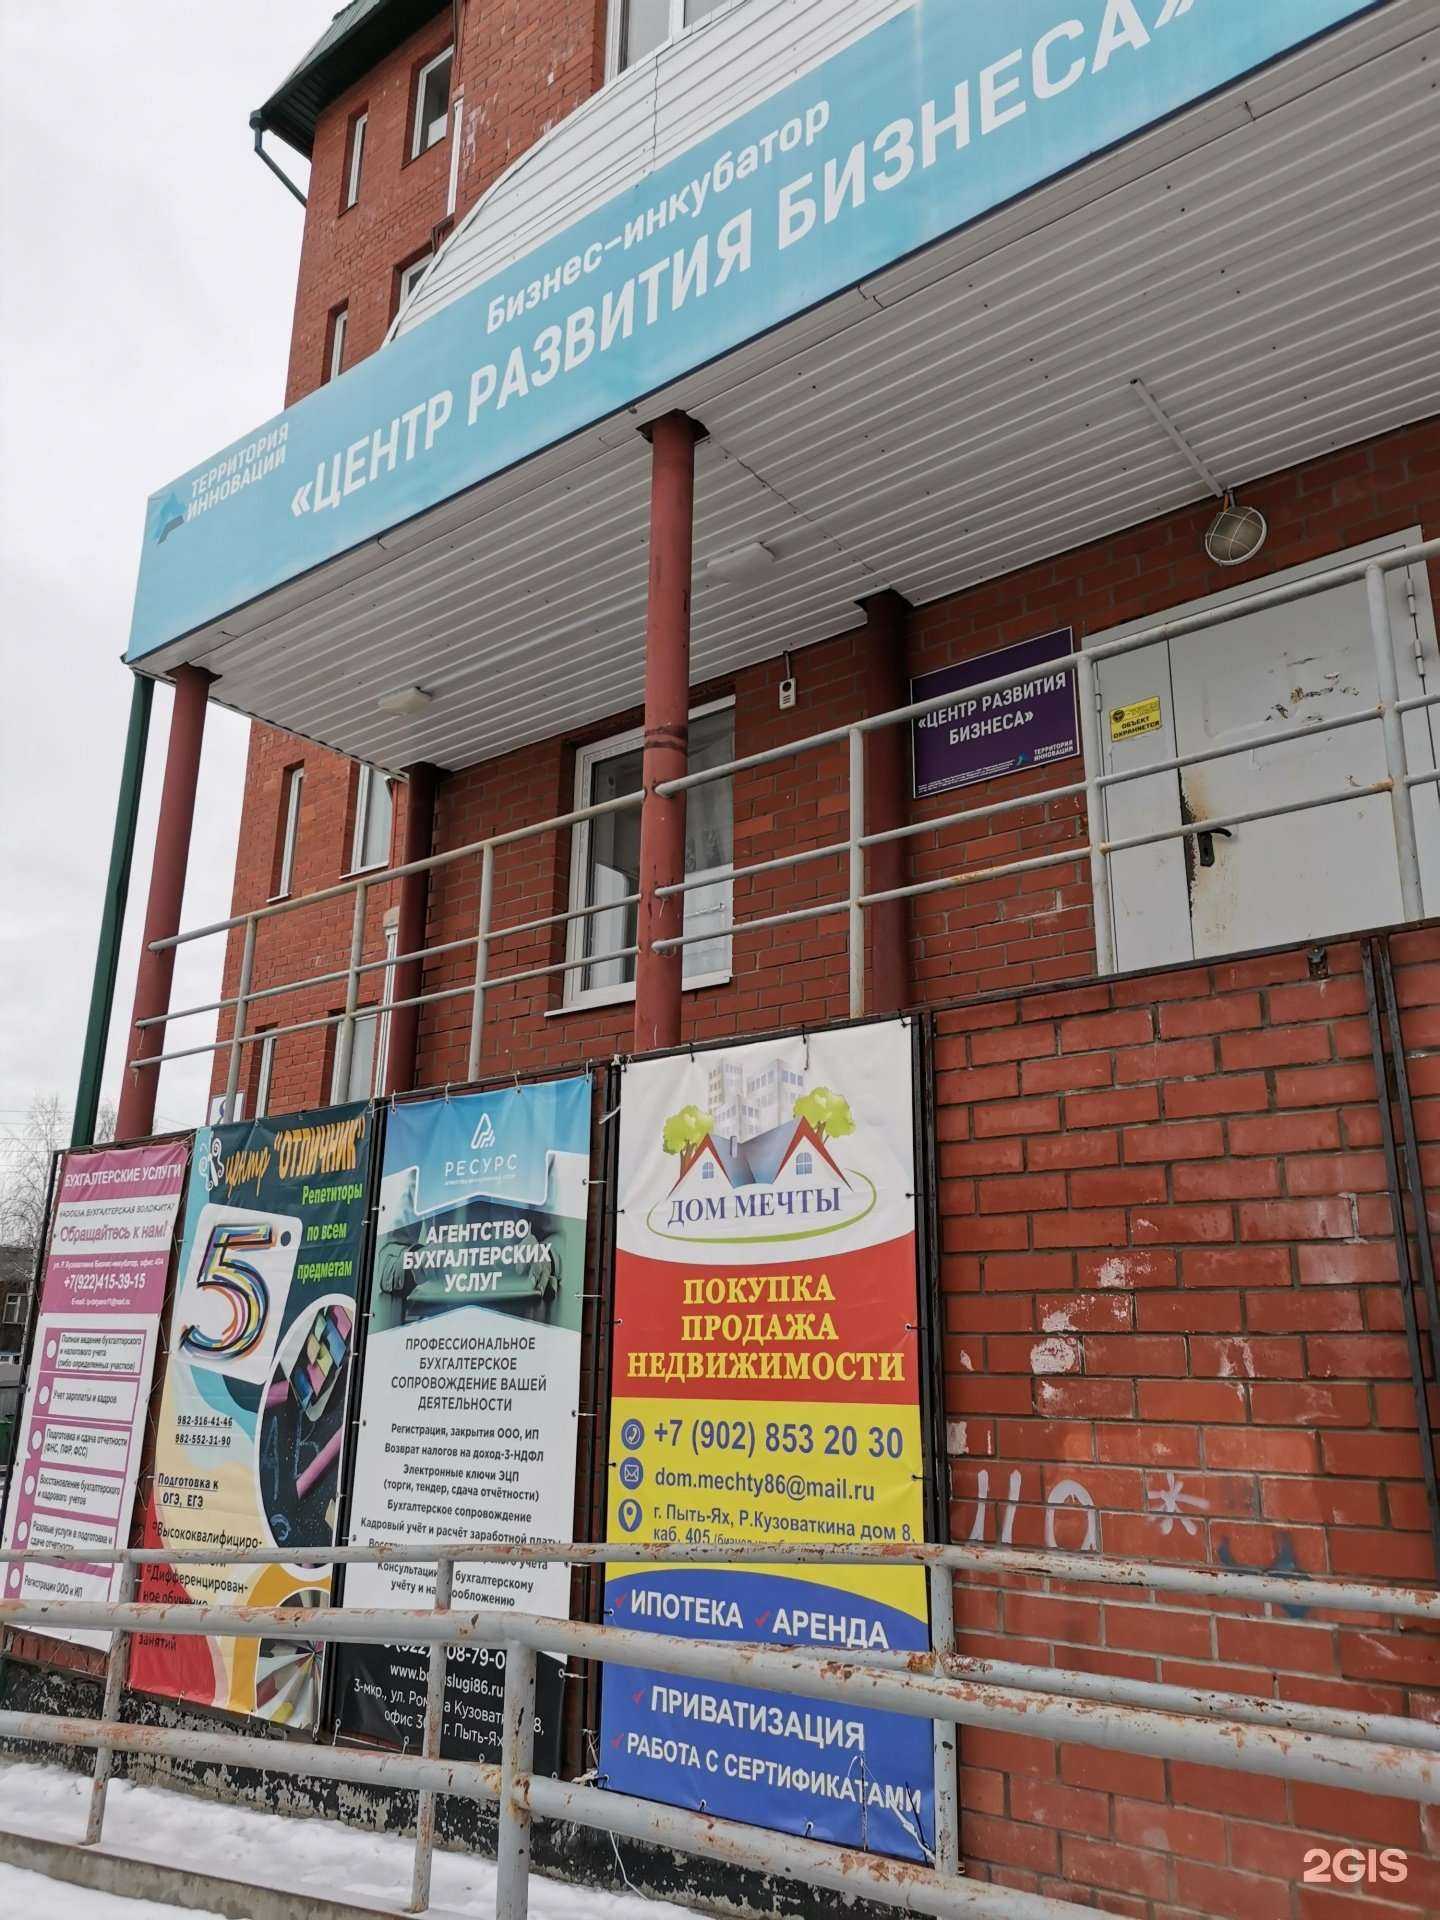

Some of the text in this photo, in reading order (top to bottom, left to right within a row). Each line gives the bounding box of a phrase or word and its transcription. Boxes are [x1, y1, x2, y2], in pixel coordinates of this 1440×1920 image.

[486, 100, 831, 335] Бизнес-инкубатор
[290, 387, 454, 518] «ЦЕНТР
[467, 207, 753, 427] РАЗВИТИЯ
[191, 422, 289, 498] ТЕРРИТОРИЯ
[918, 672, 1066, 729] «ЦЕНТР РАЗВИТИЯ
[949, 710, 1034, 745] БИЗНЕСА»
[64, 1164, 181, 1188] БУХГАЛТЕРСКИЕ УСЛУГИ
[445, 1154, 517, 1176] РЕСУРС
[302, 1184, 362, 1205] Репетиторы
[667, 1187, 841, 1228] ДОМ МЕЧТЫ
[60, 1220, 168, 1245] Обращайтесь к нам!
[307, 1223, 347, 1240] по всем
[426, 1219, 528, 1244] АГЕНТСТВО
[403, 1244, 552, 1270] БУХГАЛТЕРСКИХ
[64, 1273, 146, 1293] +7(922)415-39-15
[298, 1260, 352, 1284] предметам
[444, 1272, 502, 1292] УСЛУГ
[683, 1274, 836, 1305] ПОКУПКА
[680, 1313, 840, 1346] ПРОДАЖА
[405, 1337, 536, 1350] ПРОФЕССИОНАЛЬНОЕ
[419, 1358, 517, 1370] БУХГАЛТЕРСКОЕ
[627, 1352, 905, 1384] НЕДВИЖИМОСТИ
[391, 1375, 547, 1392] СОПРОВОЖДЕНИЕ ВАШЕЙ
[418, 1397, 512, 1412] ДЕЯТЕЛЬНОСТИ
[391, 1423, 539, 1441] Регистрация, закрытия ООО, ИП
[654, 1419, 903, 1459] +7 (902) 853 20 30
[385, 1443, 544, 1462] Возврат налогов на доход-3-НДФЛ
[158, 1473, 219, 1489] Подготовка к
[403, 1464, 519, 1482] Электронные ключи ЭЦП
[655, 1468, 875, 1501] dom.mechty86@mail.ru
[162, 1492, 204, 1507] ОГЭ, ЕГЭ
[383, 1479, 540, 1501] (торги, тендер, сдача отчётности)
[387, 1500, 532, 1523] Бухгалтерское сопровождение
[654, 1507, 662, 1519] г.
[666, 1504, 734, 1525] Пыть-Ях,
[739, 1510, 856, 1538] Р.Кузоваткина
[860, 1524, 896, 1541] дом
[361, 1517, 404, 1531] Кадровый
[406, 1520, 427, 1534] учёт
[436, 1526, 467, 1538] расчёт
[470, 1530, 527, 1545] заработной
[686, 1529, 710, 1544] 405
[391, 1579, 416, 1593] учёту
[455, 1571, 534, 1593] бухгалтерскому
[630, 1589, 889, 1649] ИПОТЕКА АРЕНДА
[391, 1688, 405, 1704] ул.
[384, 1710, 413, 1726] офис
[444, 1723, 451, 1735] г.
[651, 1685, 864, 1751] ПРИВАТИЗАЦИЯ
[627, 1733, 921, 1815] РАБОТА С СЕРТИФИКАТАМИ
